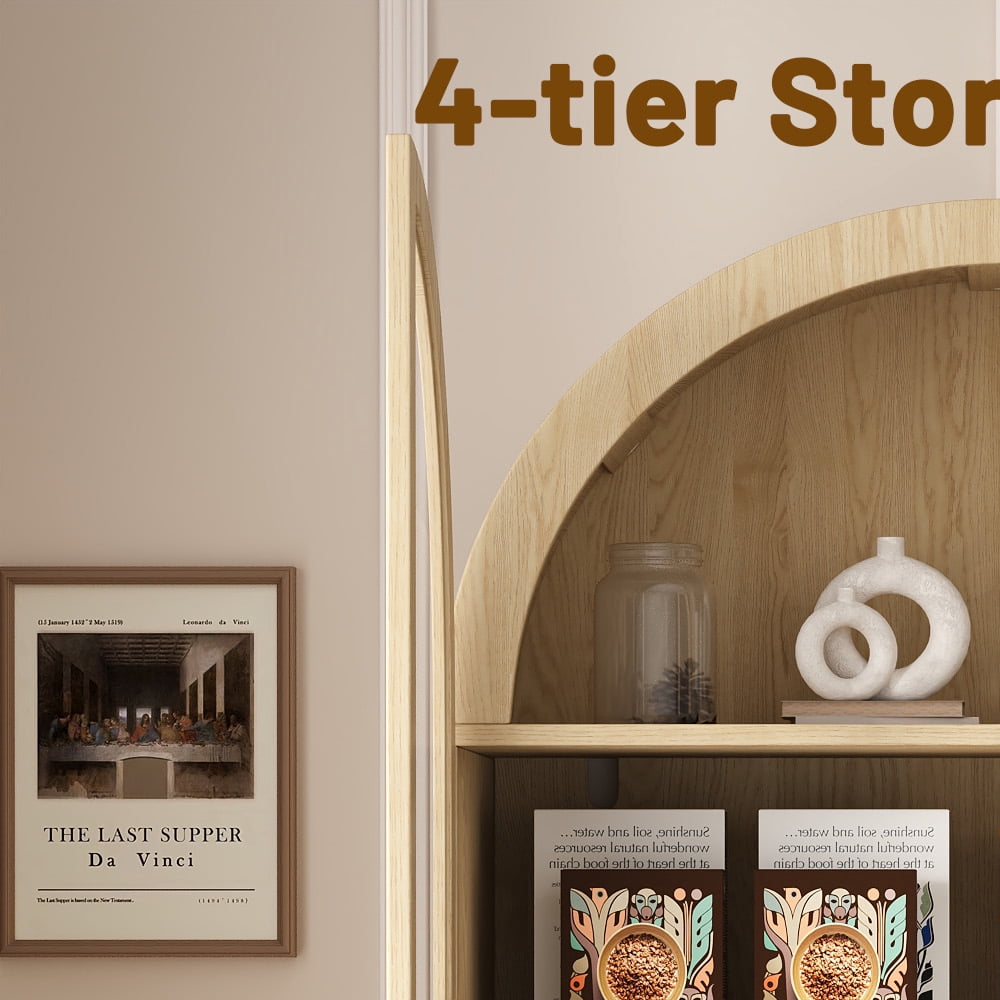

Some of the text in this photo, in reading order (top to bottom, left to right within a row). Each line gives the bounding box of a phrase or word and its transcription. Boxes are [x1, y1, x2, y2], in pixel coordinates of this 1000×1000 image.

[94, 619, 106, 627] May
[44, 827, 242, 843] THE LAST SUPPER
[88, 852, 194, 867] Da Vinci
